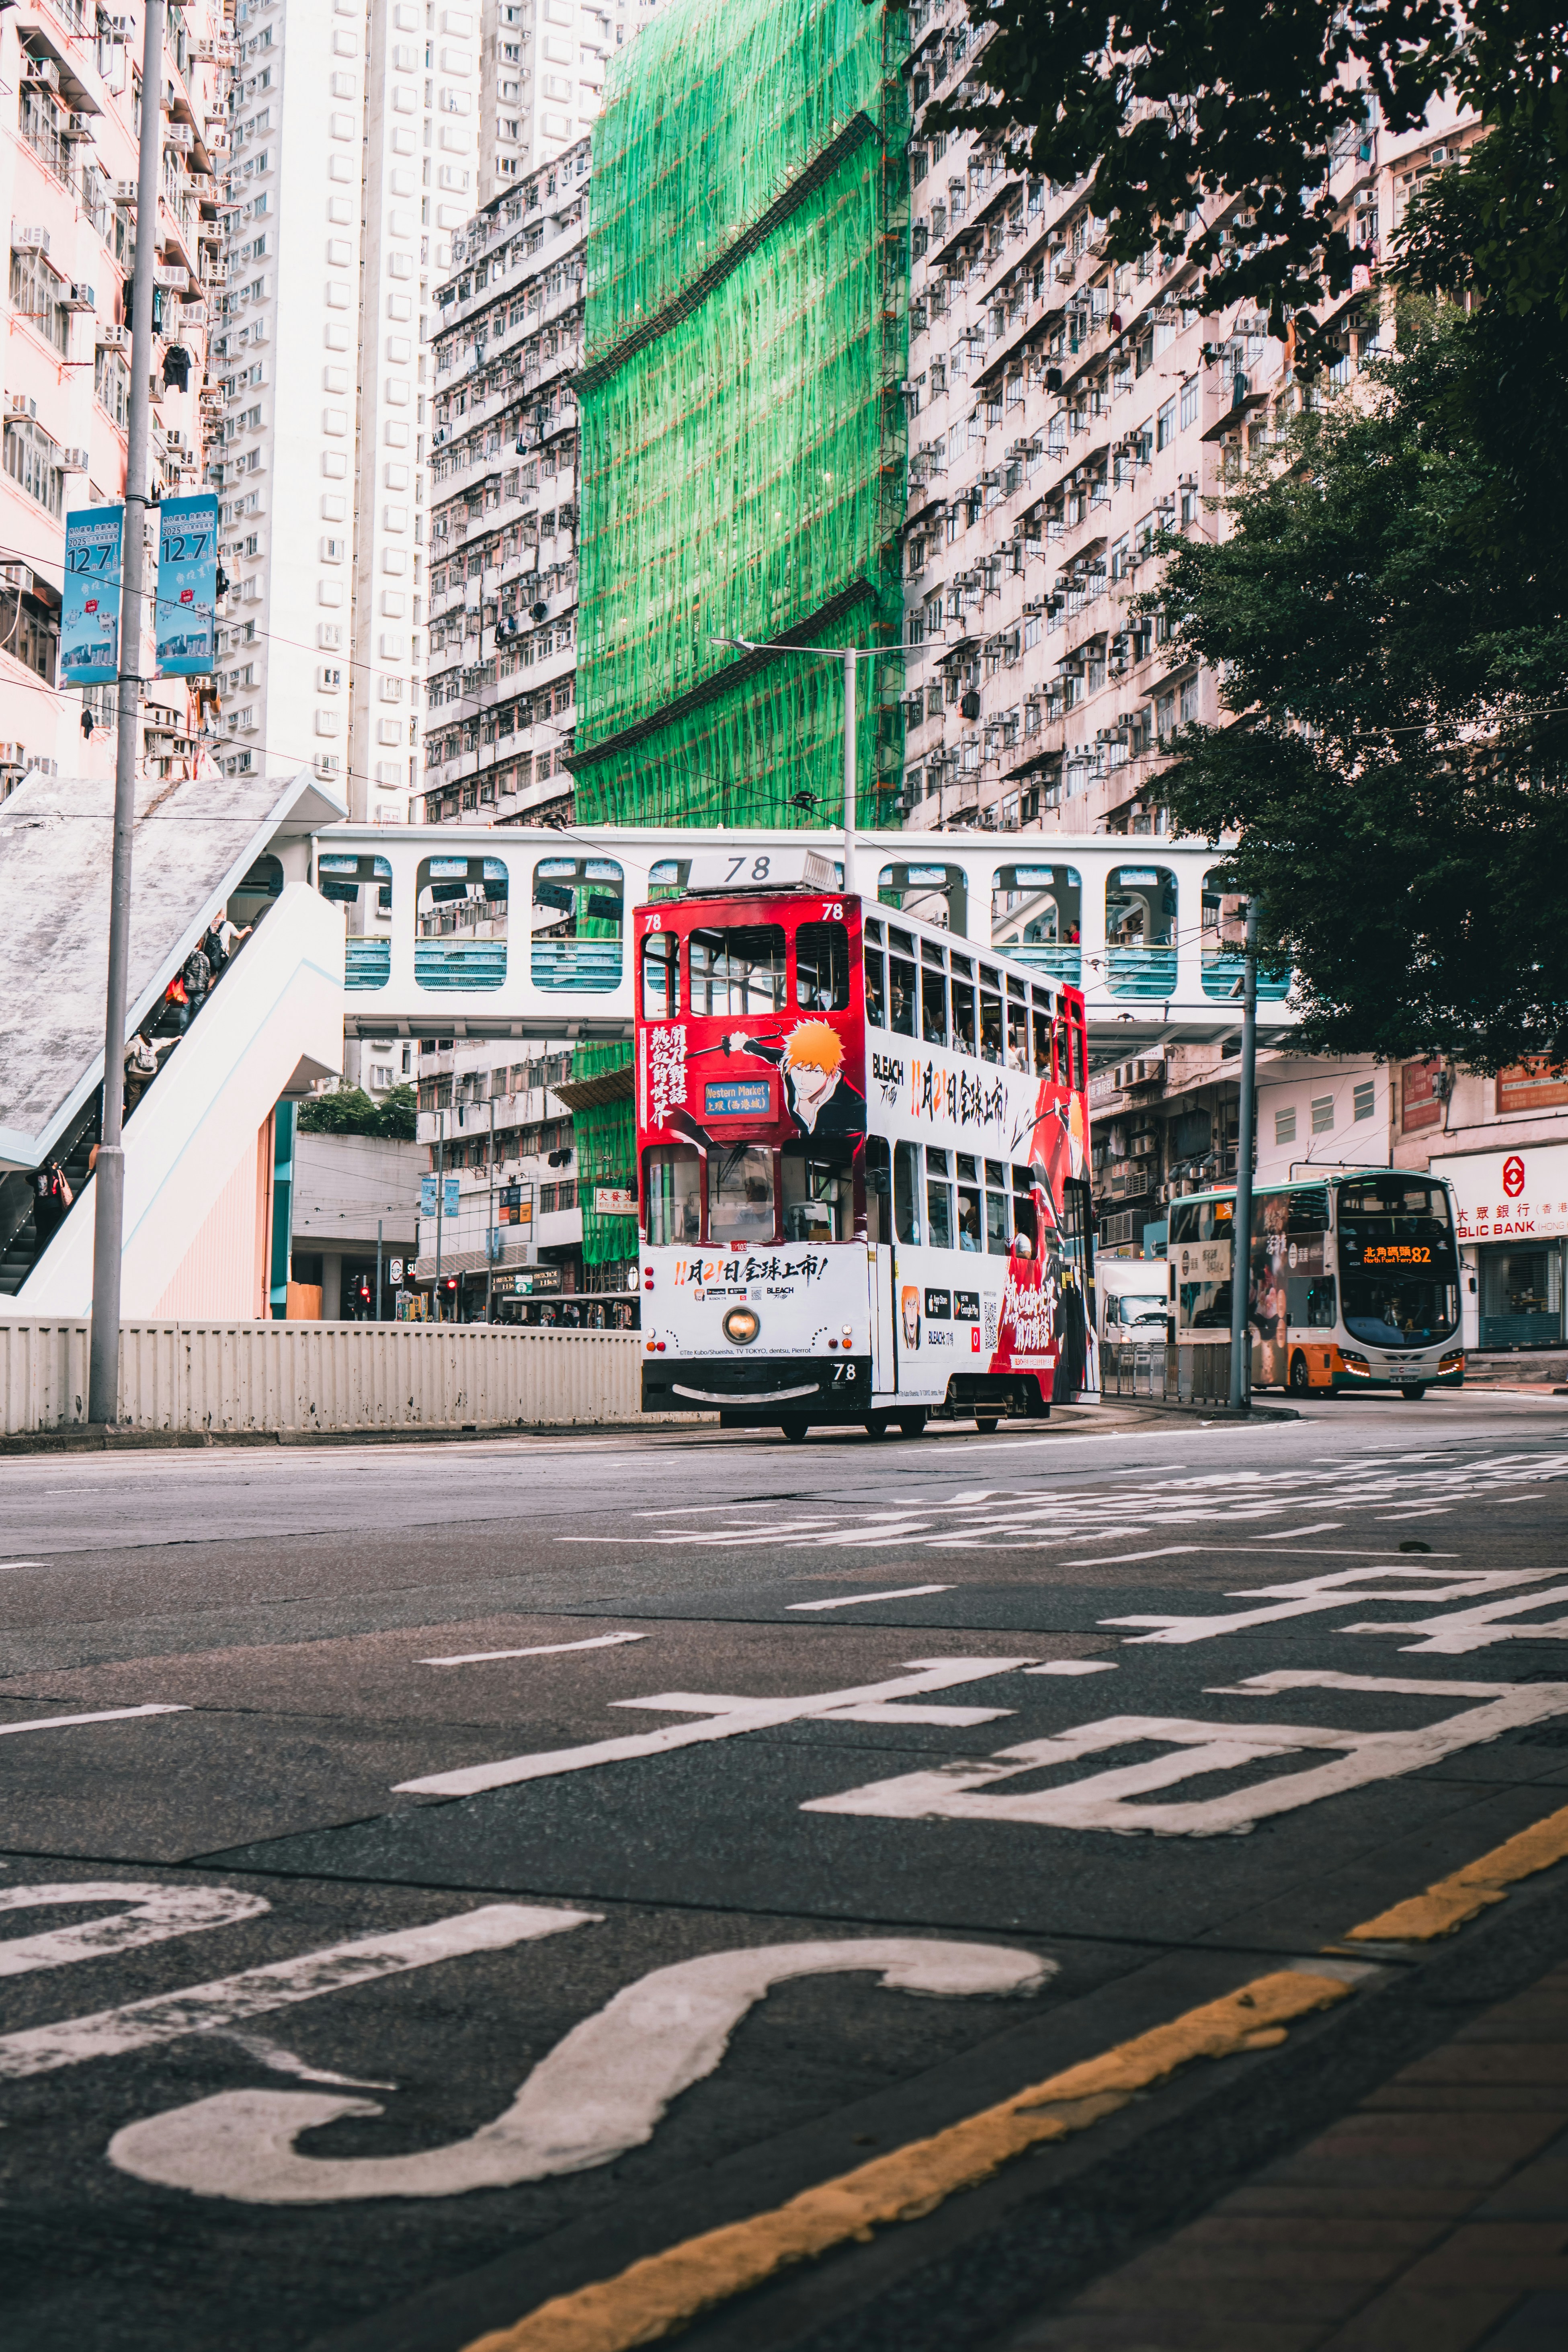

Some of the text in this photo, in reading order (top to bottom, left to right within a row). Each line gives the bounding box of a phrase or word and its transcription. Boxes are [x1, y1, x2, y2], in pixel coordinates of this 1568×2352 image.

[190, 511, 214, 519] 共創未來
[95, 523, 119, 531] 共創未來
[162, 527, 180, 536] 2025
[68, 538, 86, 547] 2025
[724, 856, 770, 882] 78
[822, 903, 843, 921] 78
[645, 915, 661, 932] 78
[873, 1053, 904, 1086] BLEACH
[738, 1085, 765, 1096] Market
[1457, 1203, 1530, 1222] 大眾銀行
[1455, 1225, 1489, 1238] BLIC
[1494, 1221, 1535, 1235] BANK
[1364, 1247, 1411, 1257] 北角碼頭
[1412, 1247, 1431, 1262] 82
[674, 1255, 828, 1288] 11月21日全球上市!
[961, 1303, 972, 1317] Google
[832, 1363, 856, 1380] 78
